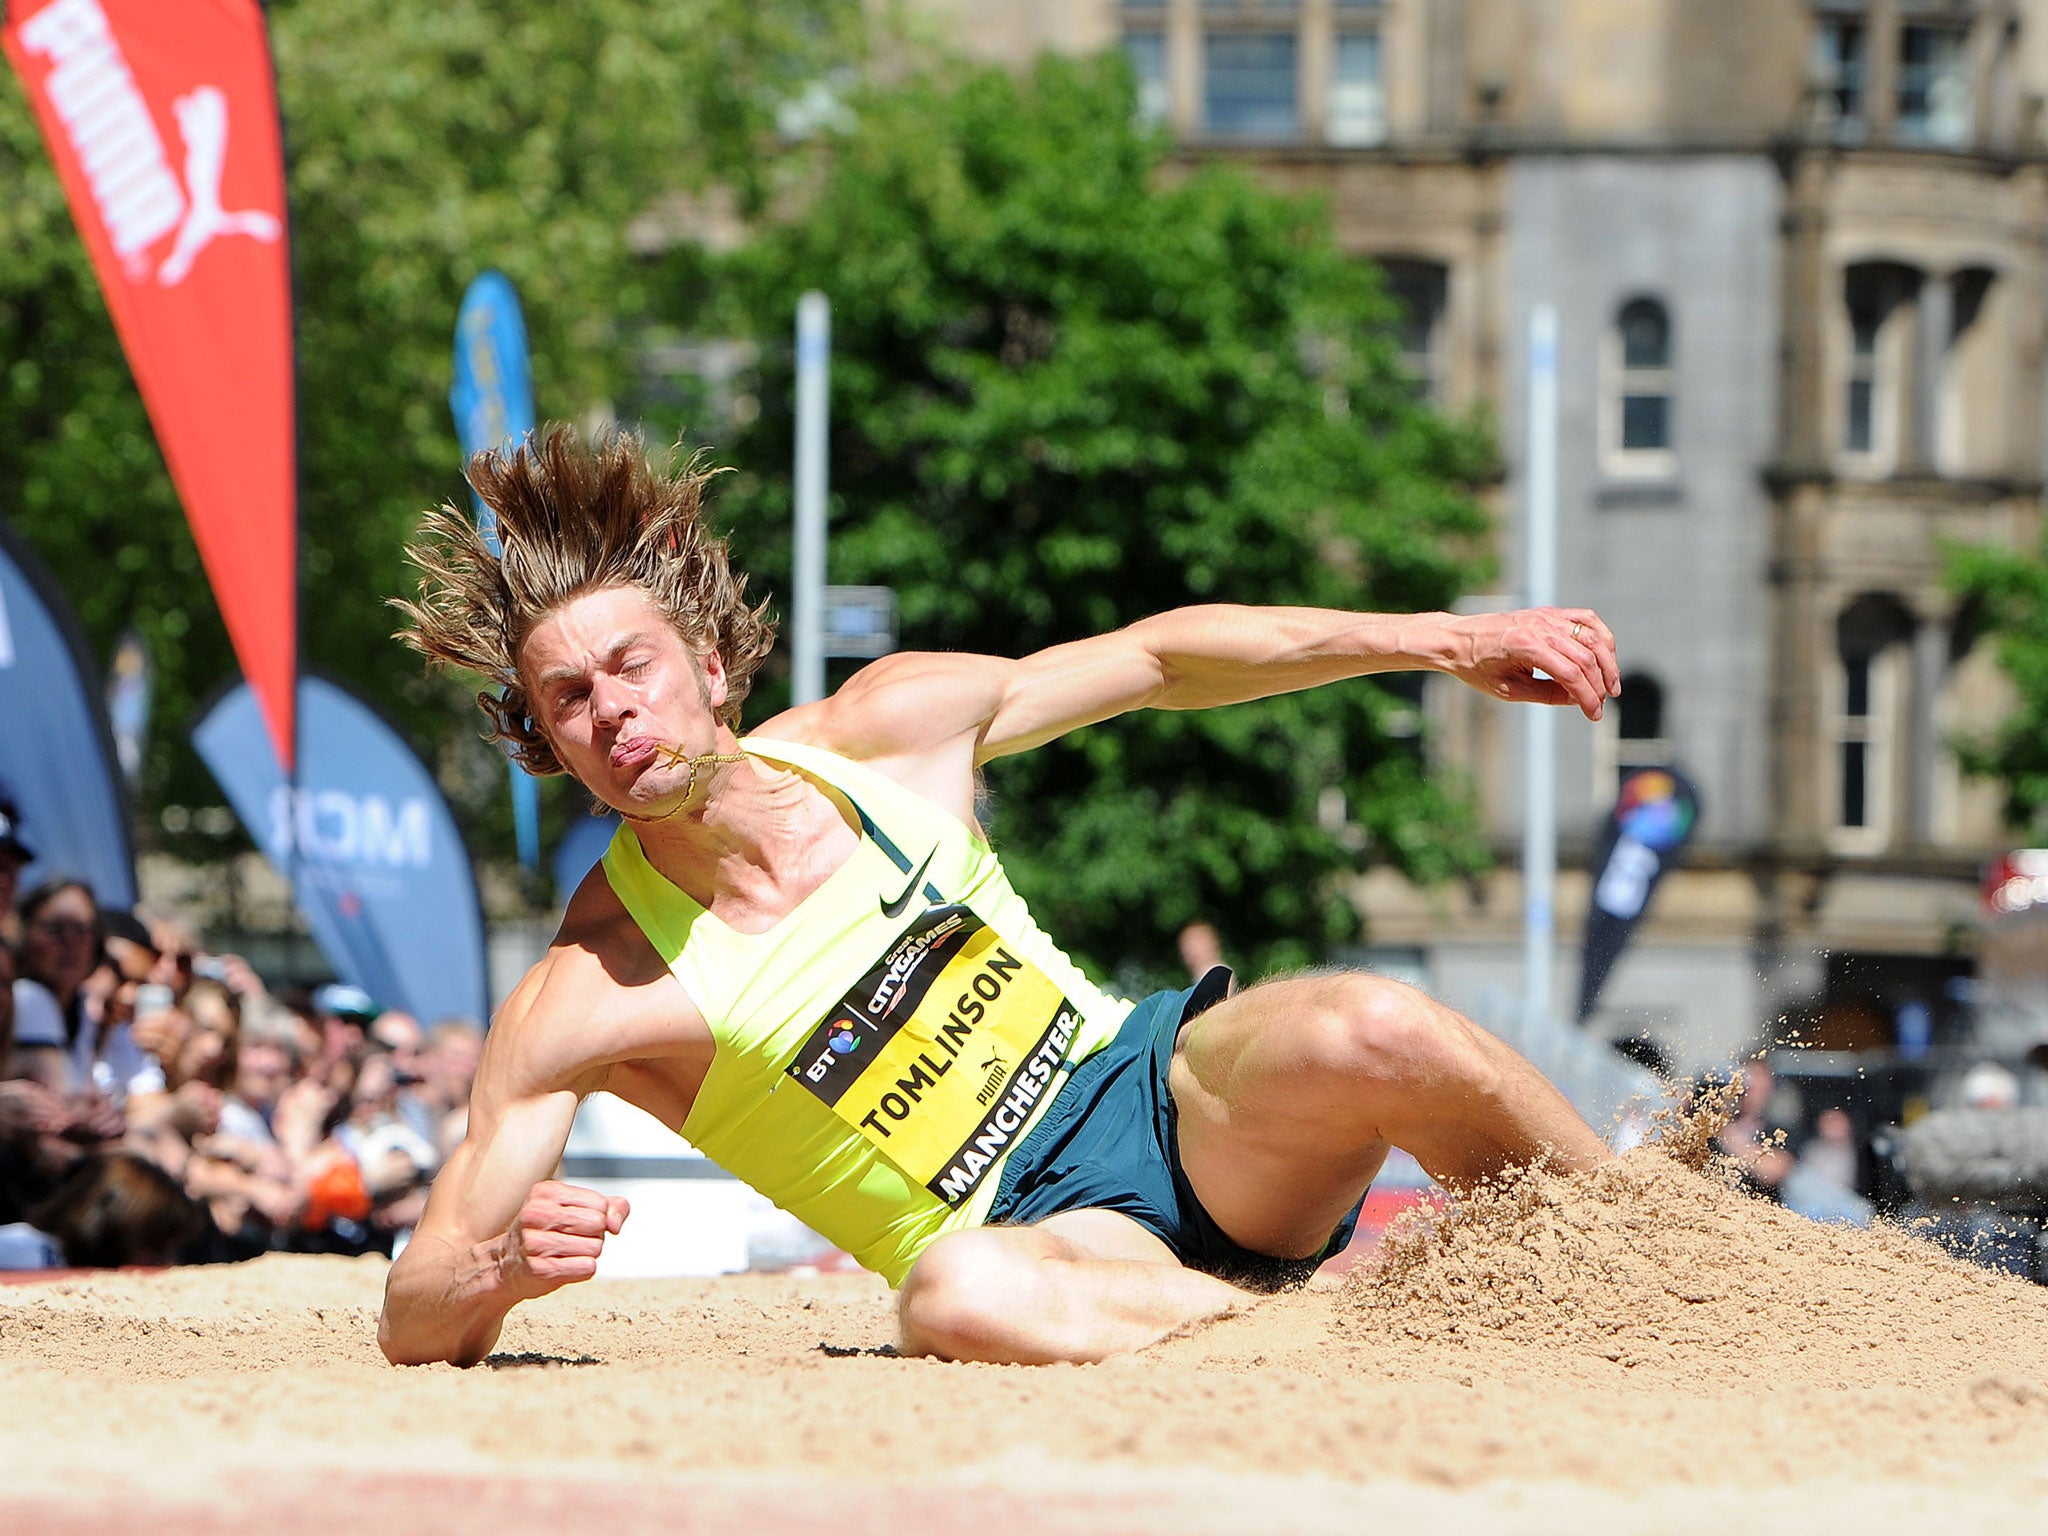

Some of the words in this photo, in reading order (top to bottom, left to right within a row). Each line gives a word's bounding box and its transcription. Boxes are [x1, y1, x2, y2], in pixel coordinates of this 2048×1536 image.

[868, 913, 962, 1014] CITYGAMES
[806, 1048, 836, 1083] BT
[860, 946, 1023, 1138] TOMLINSON
[976, 1064, 1007, 1106] PUMA
[938, 1010, 1078, 1200] MANCHESTER
